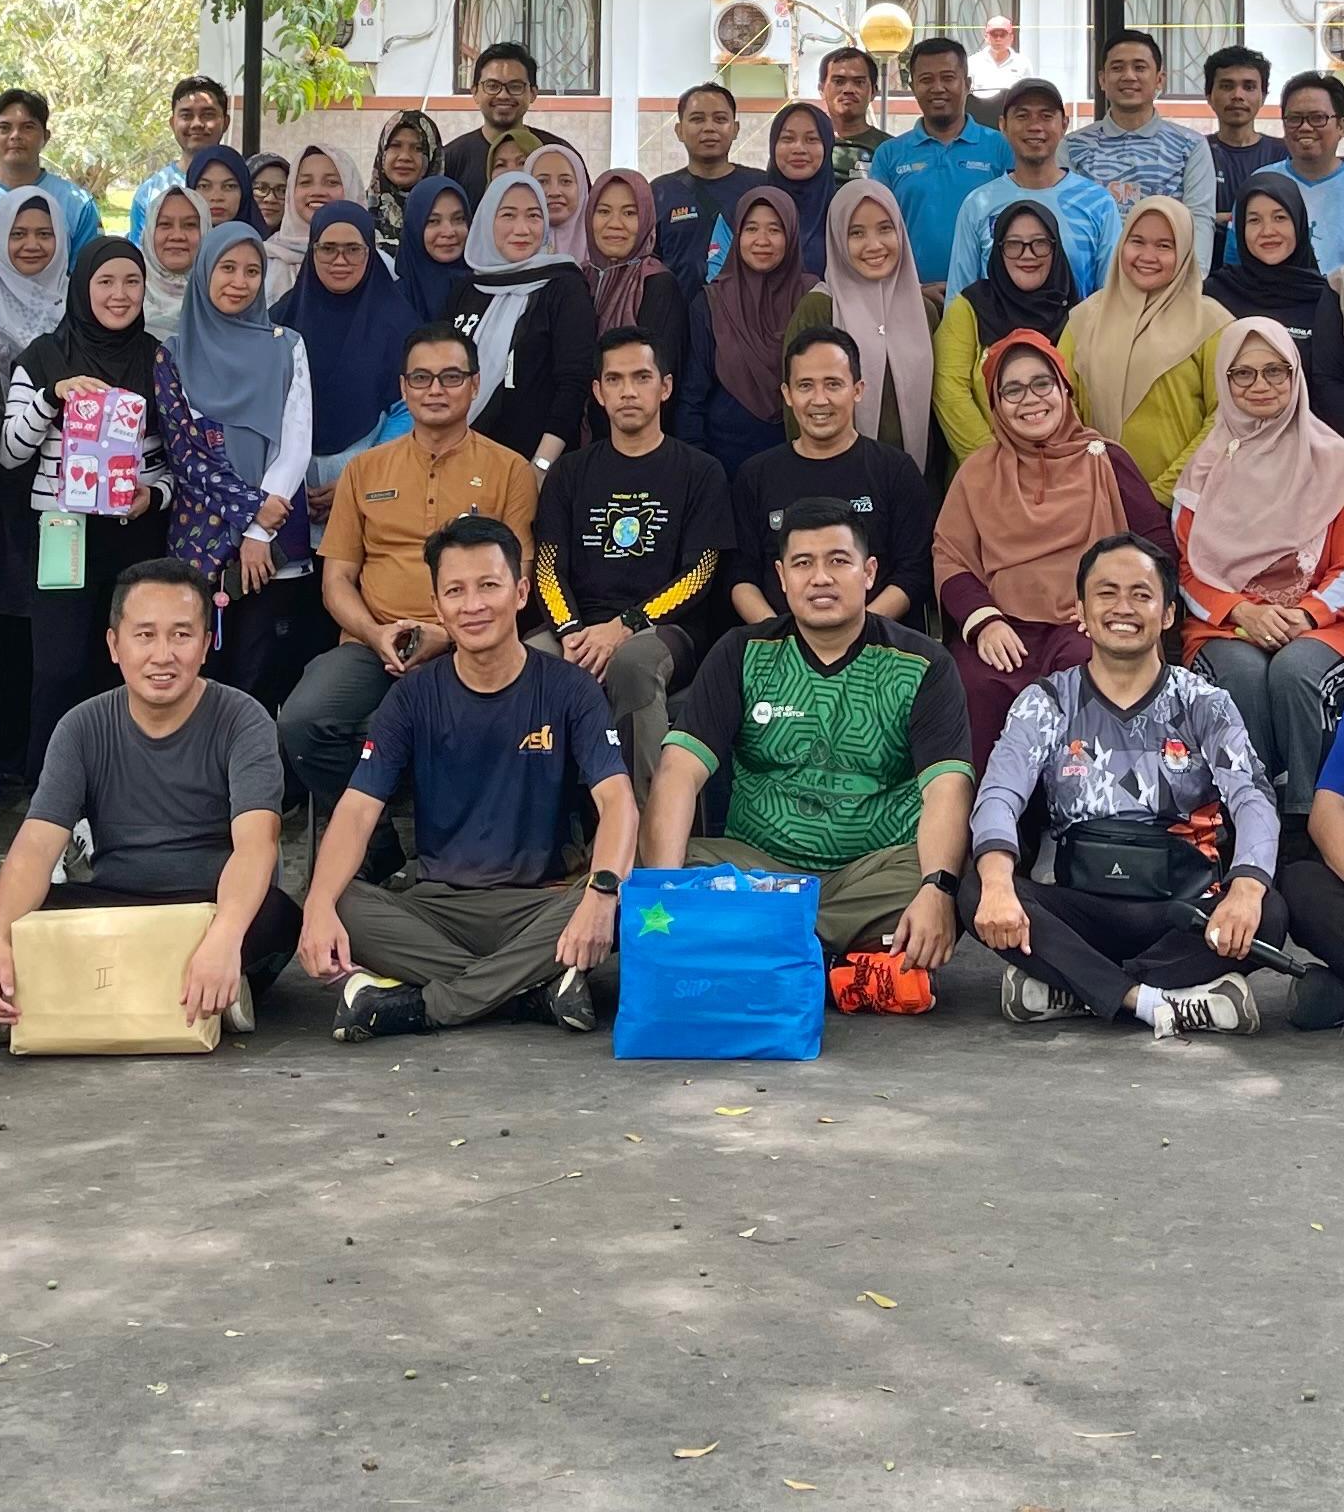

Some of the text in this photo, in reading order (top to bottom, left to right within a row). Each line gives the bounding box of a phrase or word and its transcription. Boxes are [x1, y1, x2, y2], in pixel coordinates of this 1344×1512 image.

[360, 18, 374, 27] LG
[776, 19, 790, 28] LG
[852, 502, 874, 513] 023
[830, 776, 855, 791] FC
